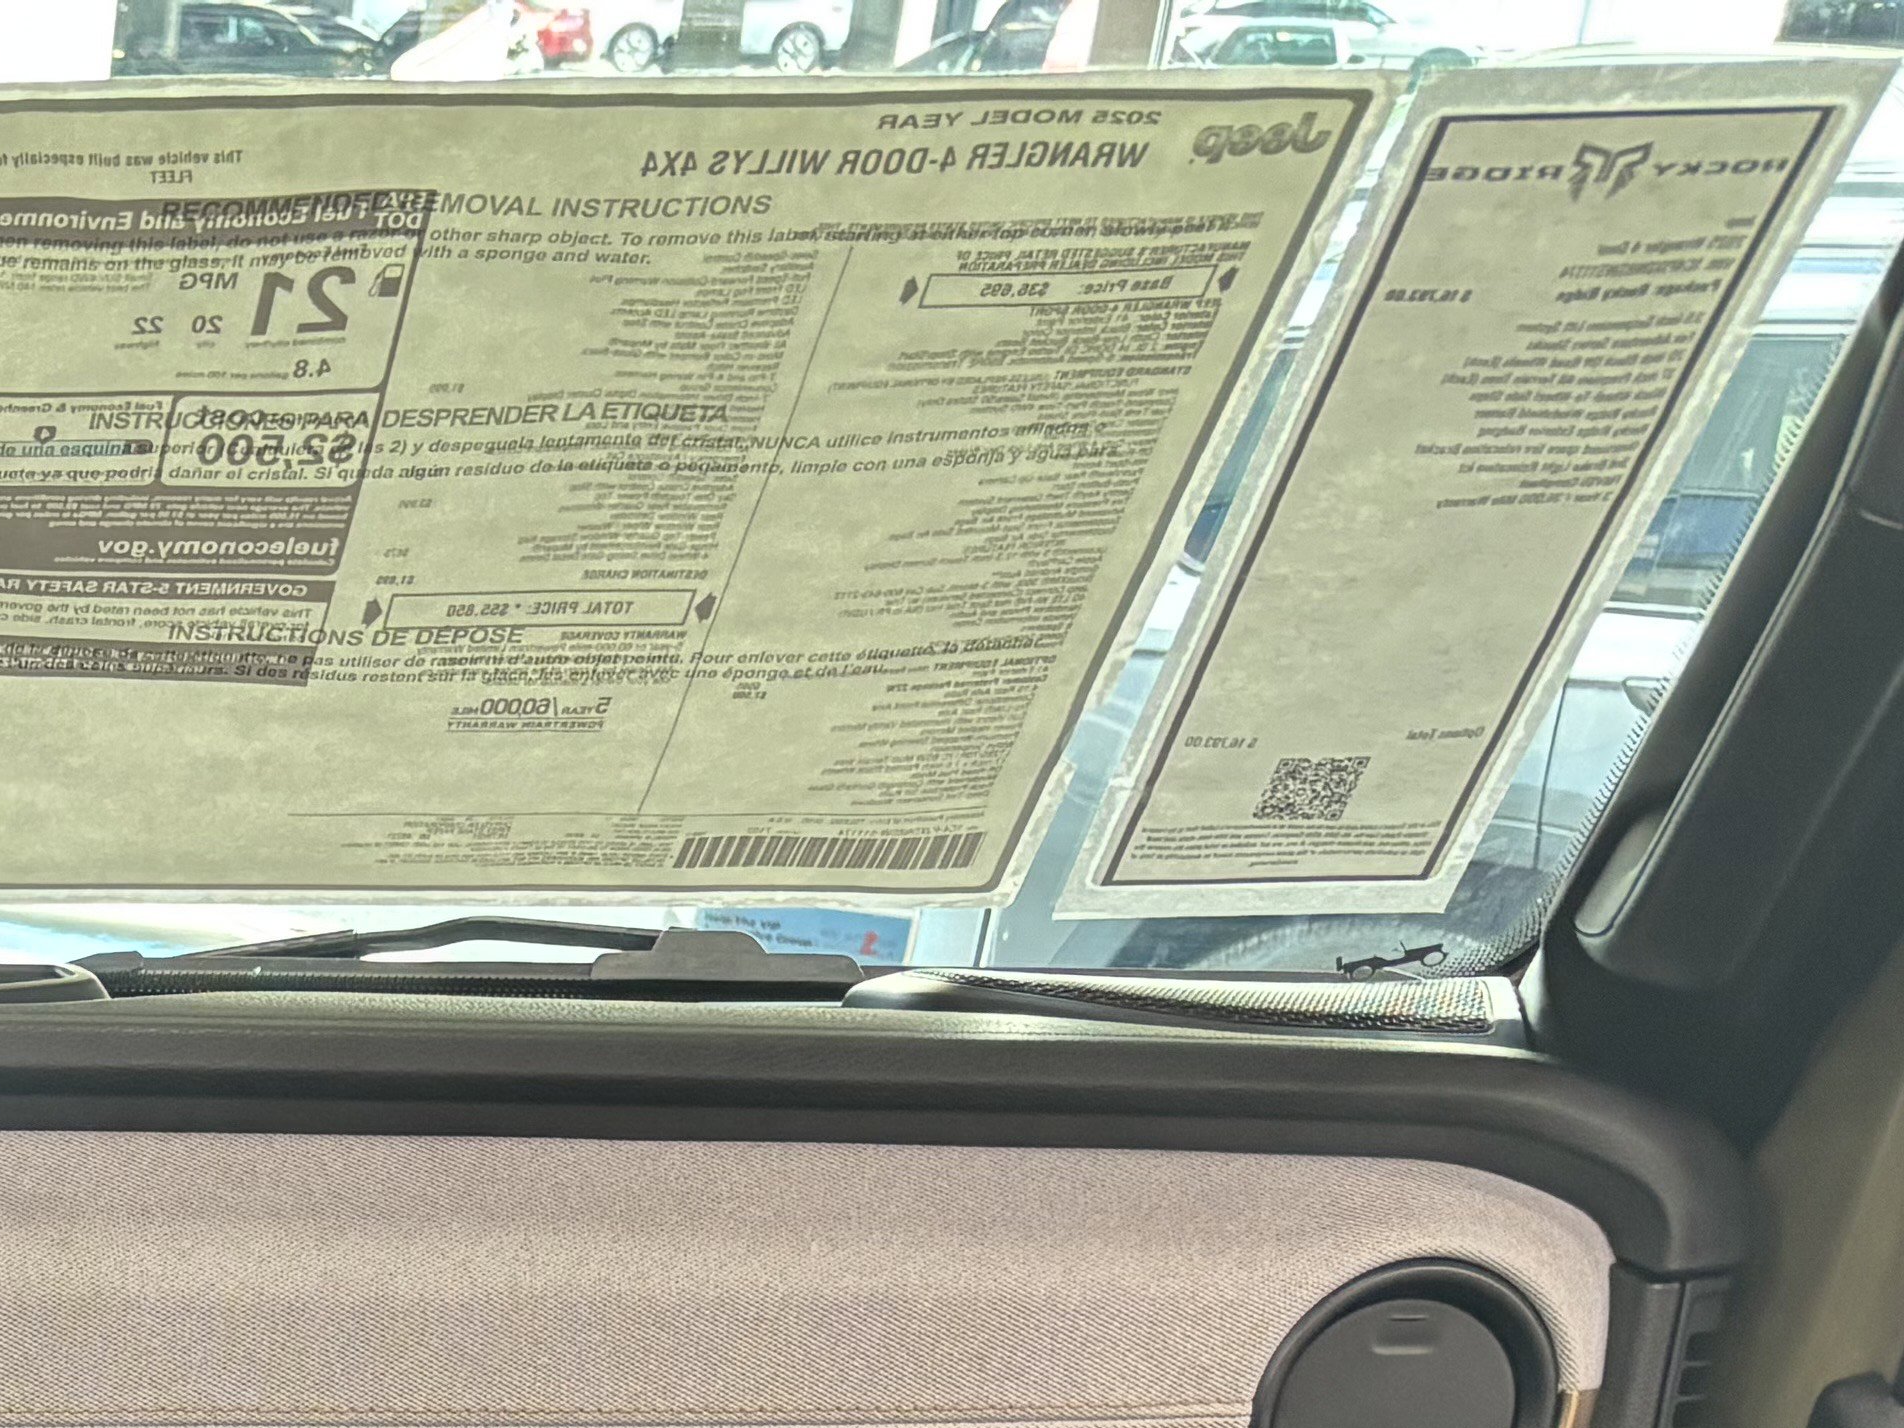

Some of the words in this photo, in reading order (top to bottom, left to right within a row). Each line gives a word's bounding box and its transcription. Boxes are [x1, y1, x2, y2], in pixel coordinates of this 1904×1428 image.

[548, 194, 773, 220] INSTRUCTIONS
[431, 227, 482, 242] other
[487, 229, 540, 247] sharp
[381, 403, 558, 428] DESPRENDER
[563, 402, 595, 425] LA
[600, 401, 729, 427] ETIQUETA
